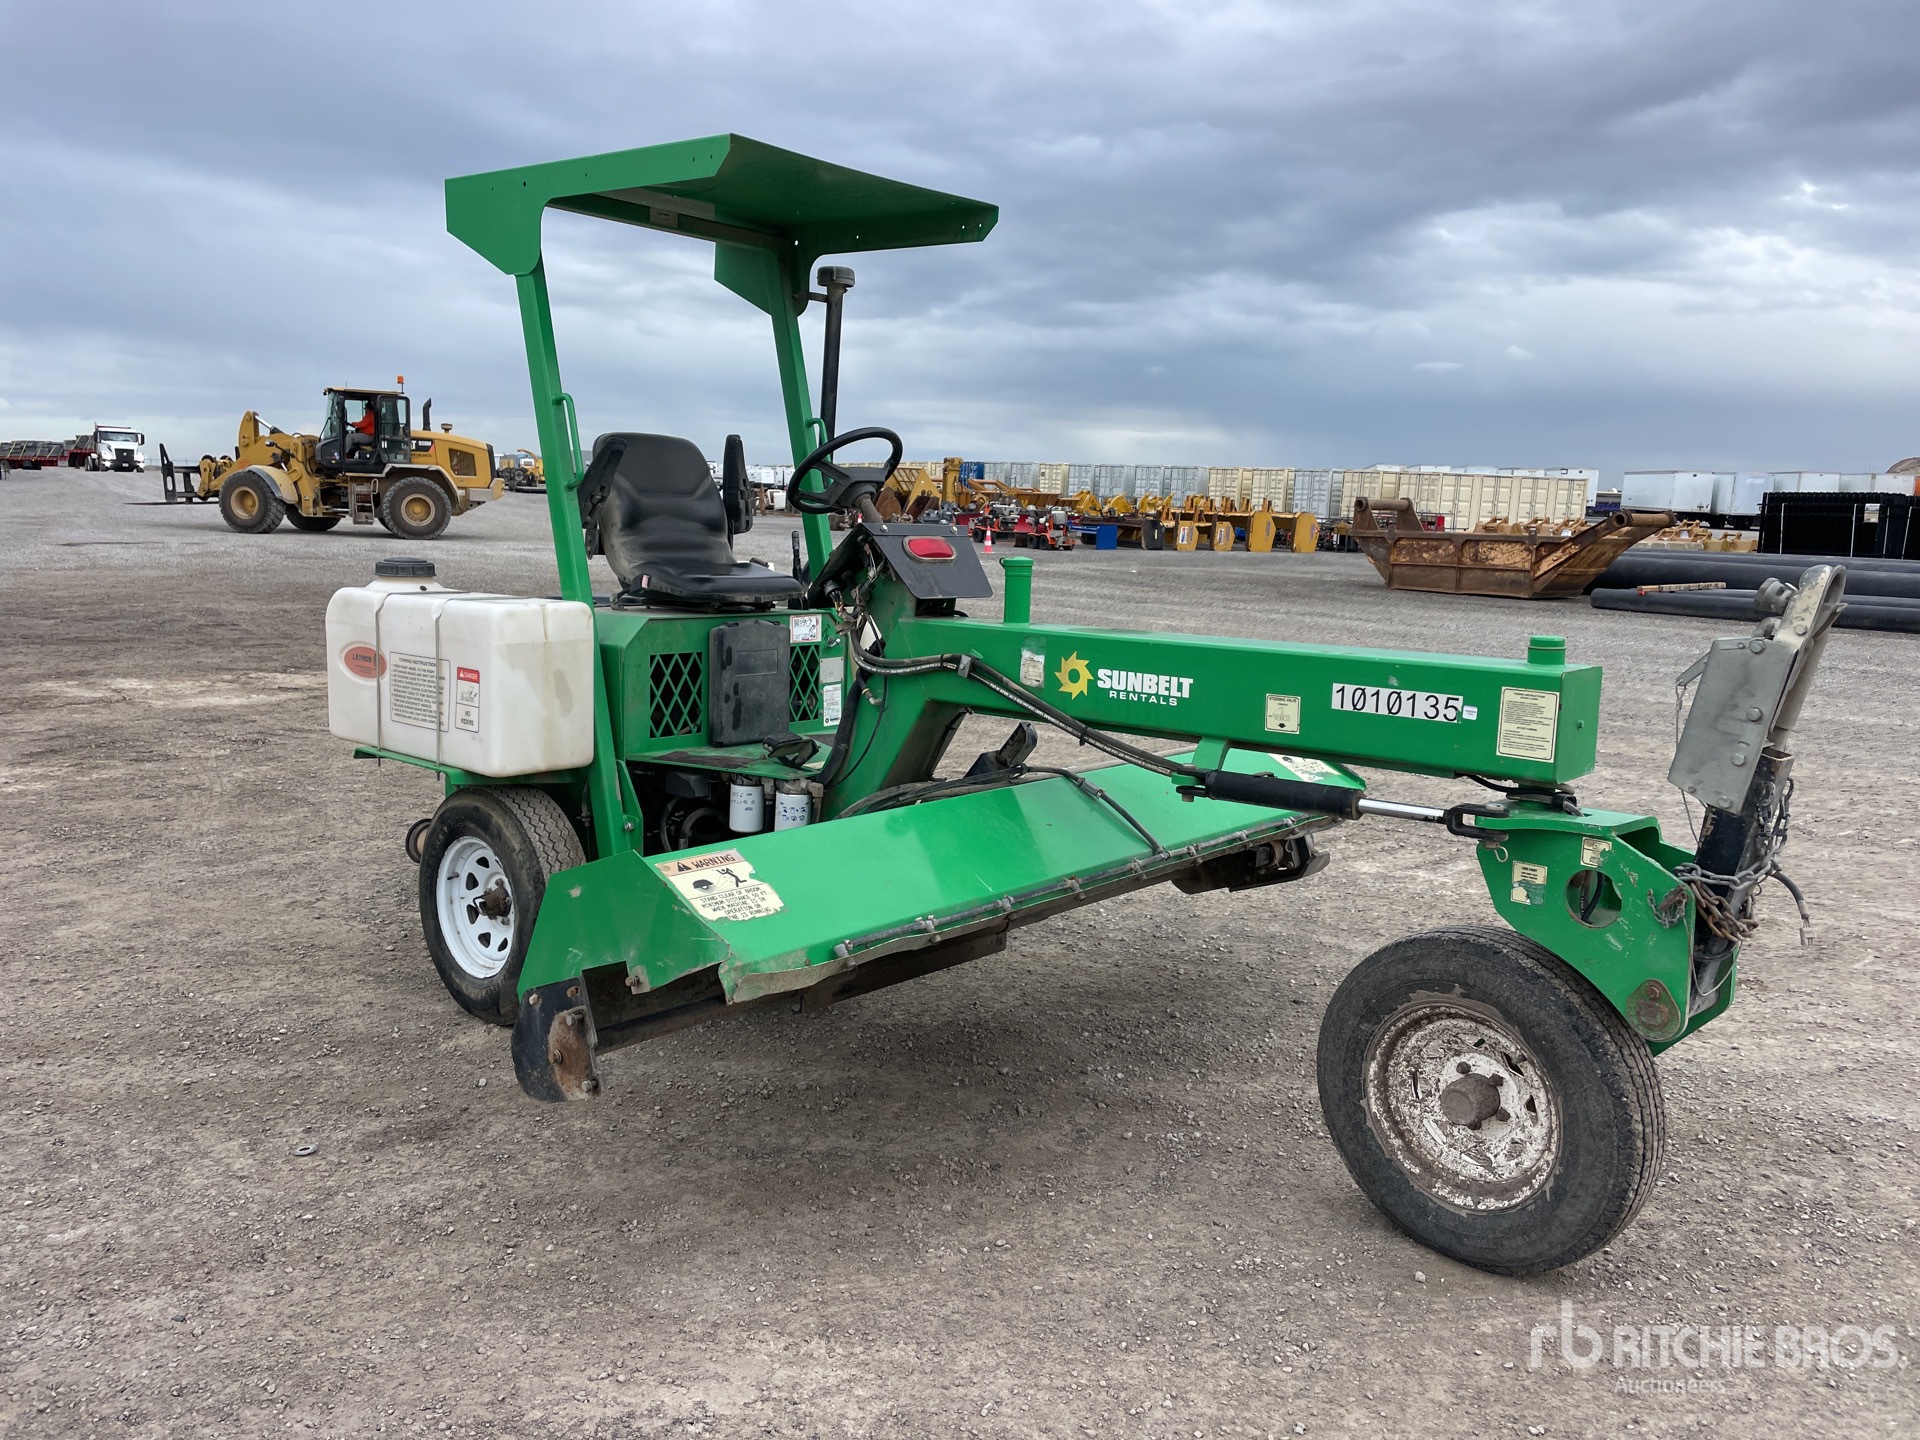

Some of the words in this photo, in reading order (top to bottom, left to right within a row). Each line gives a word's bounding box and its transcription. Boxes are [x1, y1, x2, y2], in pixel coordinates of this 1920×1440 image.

[412, 660, 437, 668] INSTRUCTION
[464, 671, 478, 680] DANGER
[1097, 668, 1194, 698] SUNBELT
[1109, 690, 1178, 706] RENTALS
[1336, 685, 1459, 722] 1010135
[461, 718, 474, 726] RIDERS
[691, 854, 735, 869] WARNING
[719, 891, 735, 899] CLEAR
[701, 900, 724, 908] MINIMUM
[725, 895, 750, 903] DISTANCE
[724, 906, 753, 915] OPERATION
[749, 907, 771, 915] RUNNING
